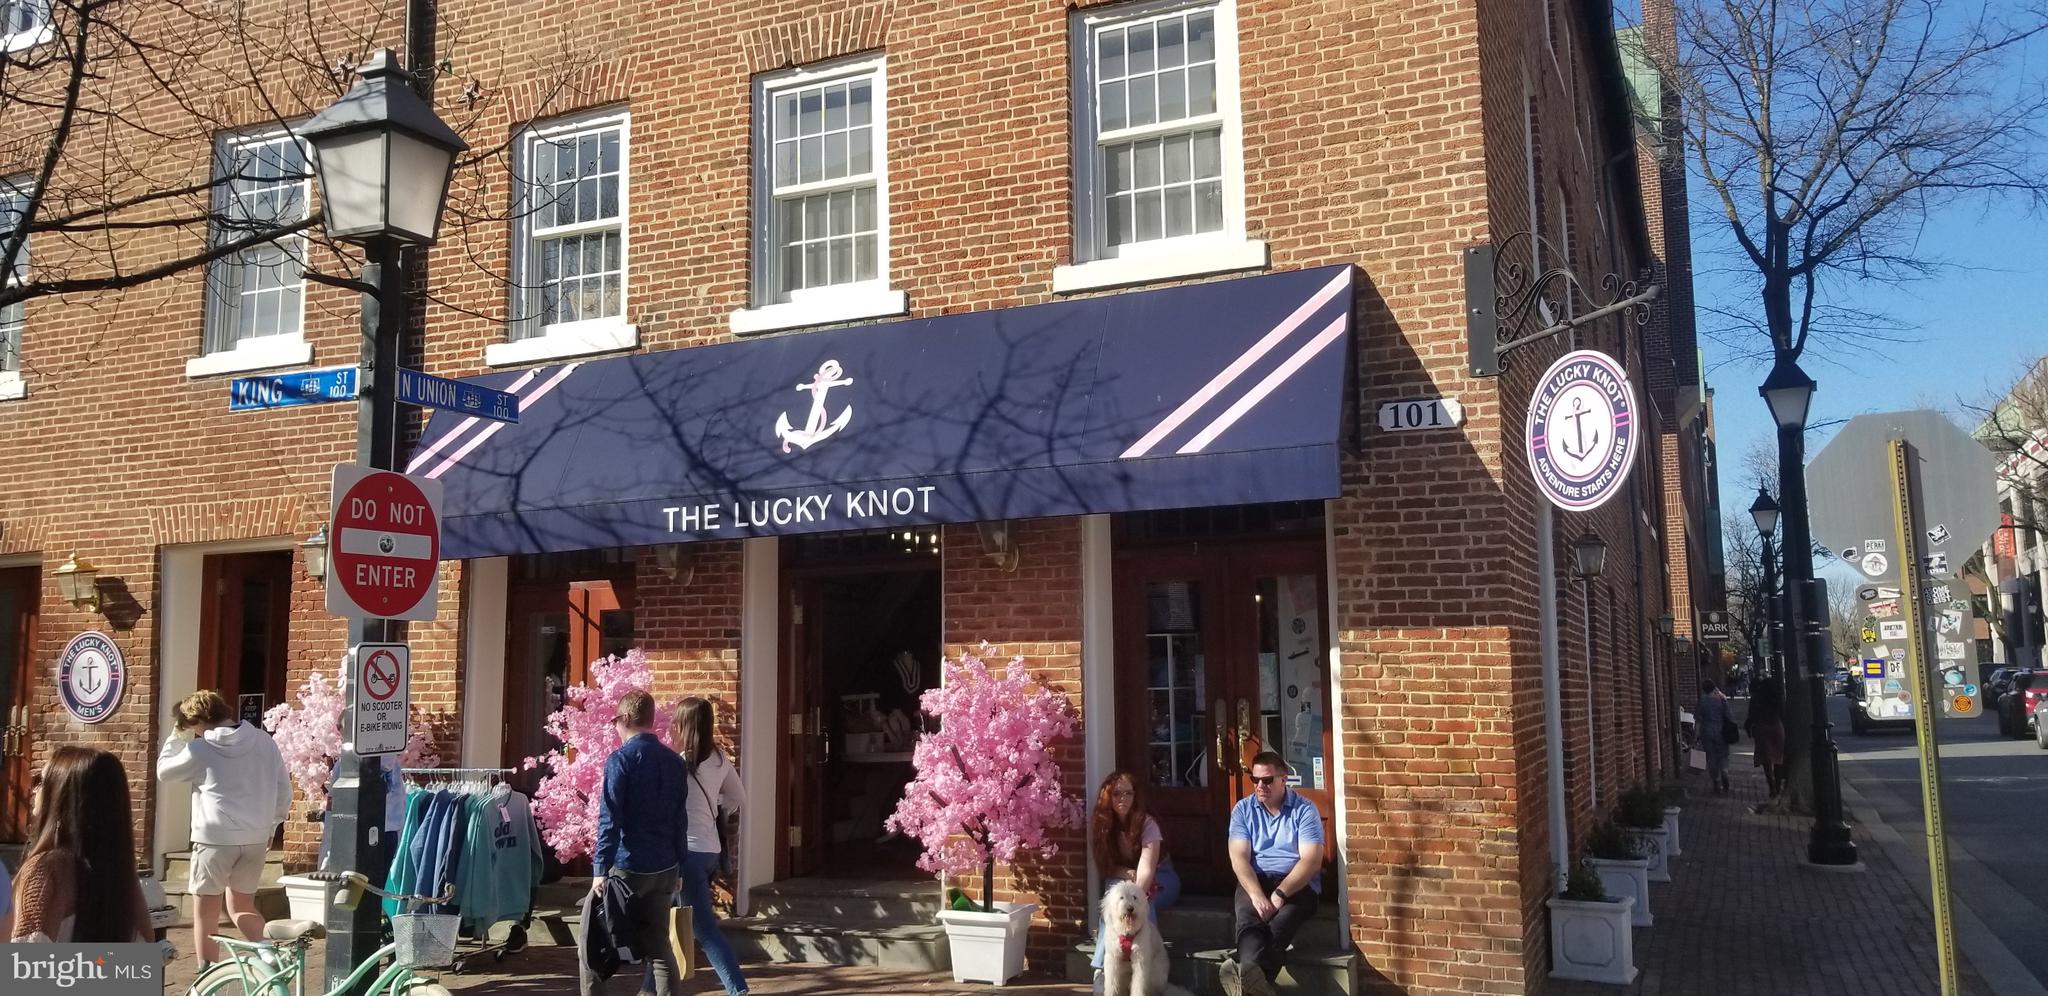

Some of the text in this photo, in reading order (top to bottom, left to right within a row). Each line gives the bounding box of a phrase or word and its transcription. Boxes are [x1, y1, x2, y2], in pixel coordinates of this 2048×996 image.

[238, 371, 349, 406] KING ST
[329, 385, 347, 398] 100
[402, 382, 509, 408] N UNION ST
[1535, 364, 1623, 425] THE LUCKY KNOT
[493, 407, 509, 419] 100
[1389, 401, 1442, 429] 101
[1538, 436, 1626, 498] ADVENTURE STARTS HERE
[351, 497, 426, 526] DO NOT
[663, 486, 936, 533] THE LUCKY KNOT
[356, 563, 416, 589] ENTER
[1702, 623, 1728, 632] PARK
[63, 638, 118, 668] THE LUCKY KNOT
[77, 704, 103, 717] MEN'S
[361, 701, 403, 712] NO SCOOTER
[376, 712, 387, 721] OR
[360, 721, 403, 732] E-BIKE RIDING
